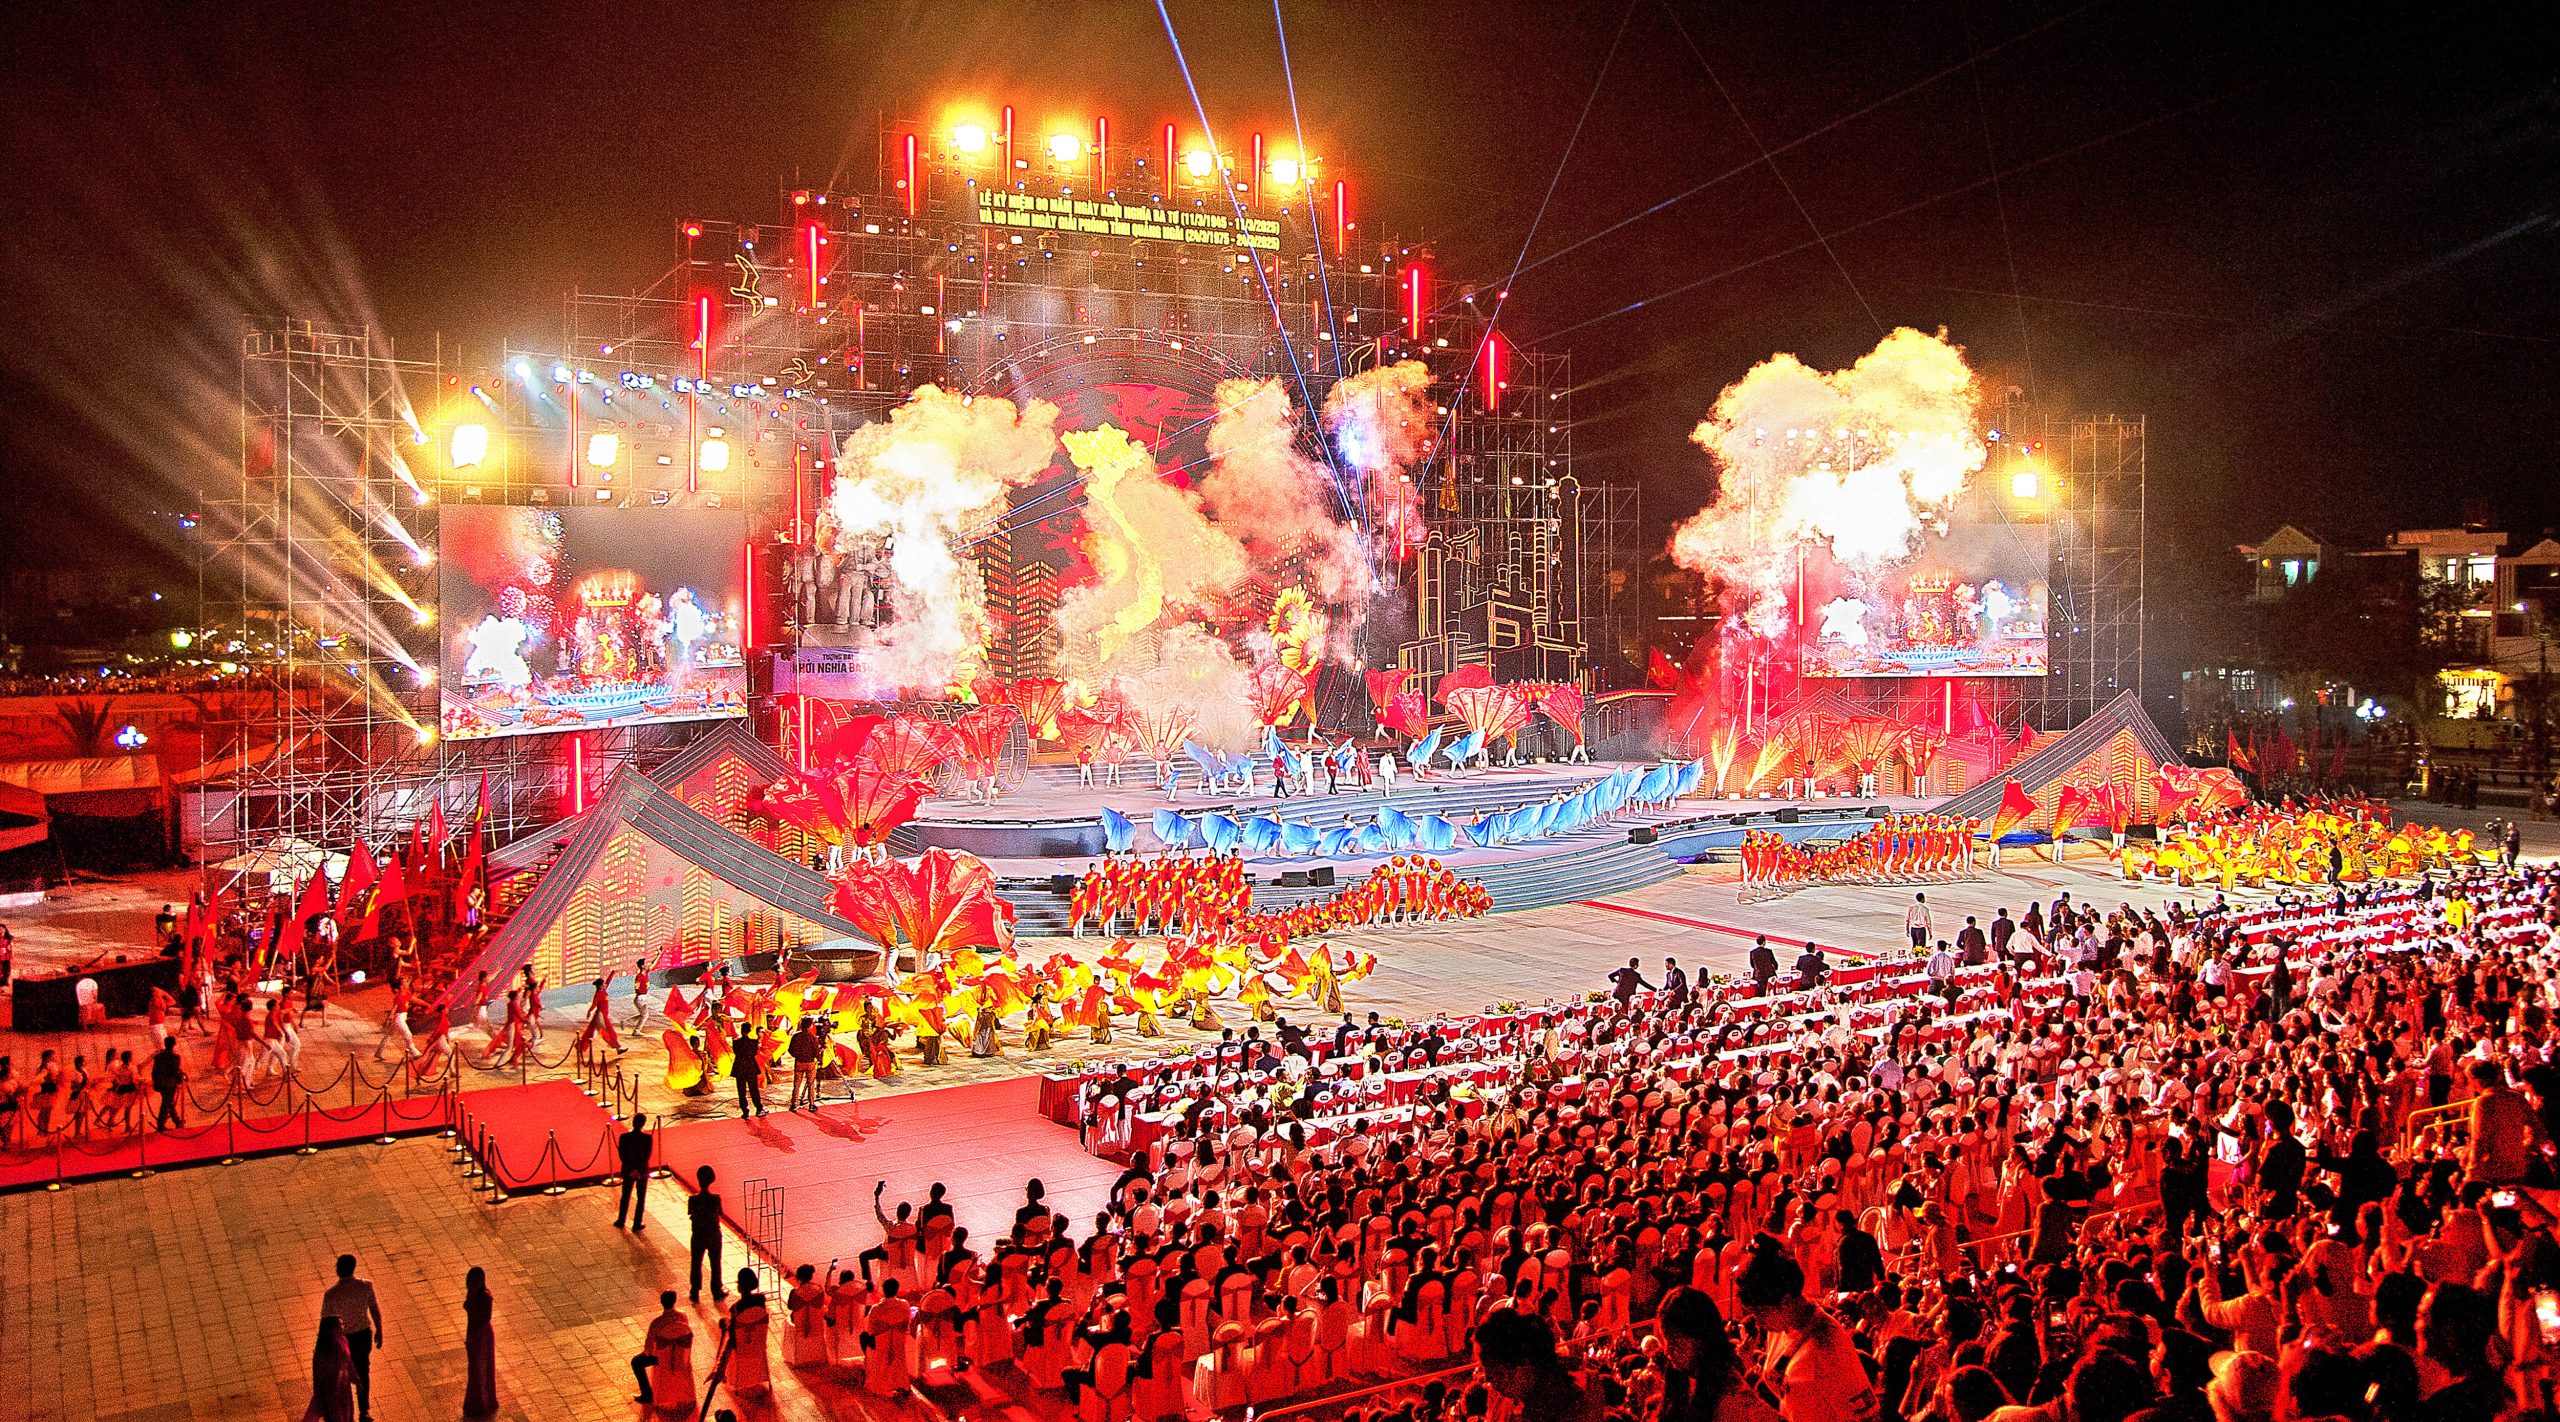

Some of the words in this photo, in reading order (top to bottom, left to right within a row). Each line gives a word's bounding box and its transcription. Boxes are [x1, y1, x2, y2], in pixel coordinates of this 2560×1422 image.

[1008, 194, 1034, 212] NIỆM
[1050, 196, 1073, 214] NĂM
[1074, 199, 1099, 216] NGÀY
[1124, 205, 1152, 222] NGHĨA
[1152, 209, 1166, 223] BA
[979, 208, 992, 223] VÀ
[994, 210, 1007, 225] 50
[1008, 209, 1031, 227] NĂM
[1031, 212, 1057, 229] NGÀY
[1078, 217, 1109, 234] PHÓNG
[1132, 219, 1161, 239] QUẢNG
[1162, 225, 1184, 241] NGÃI
[817, 660, 847, 673] NGHĨA
